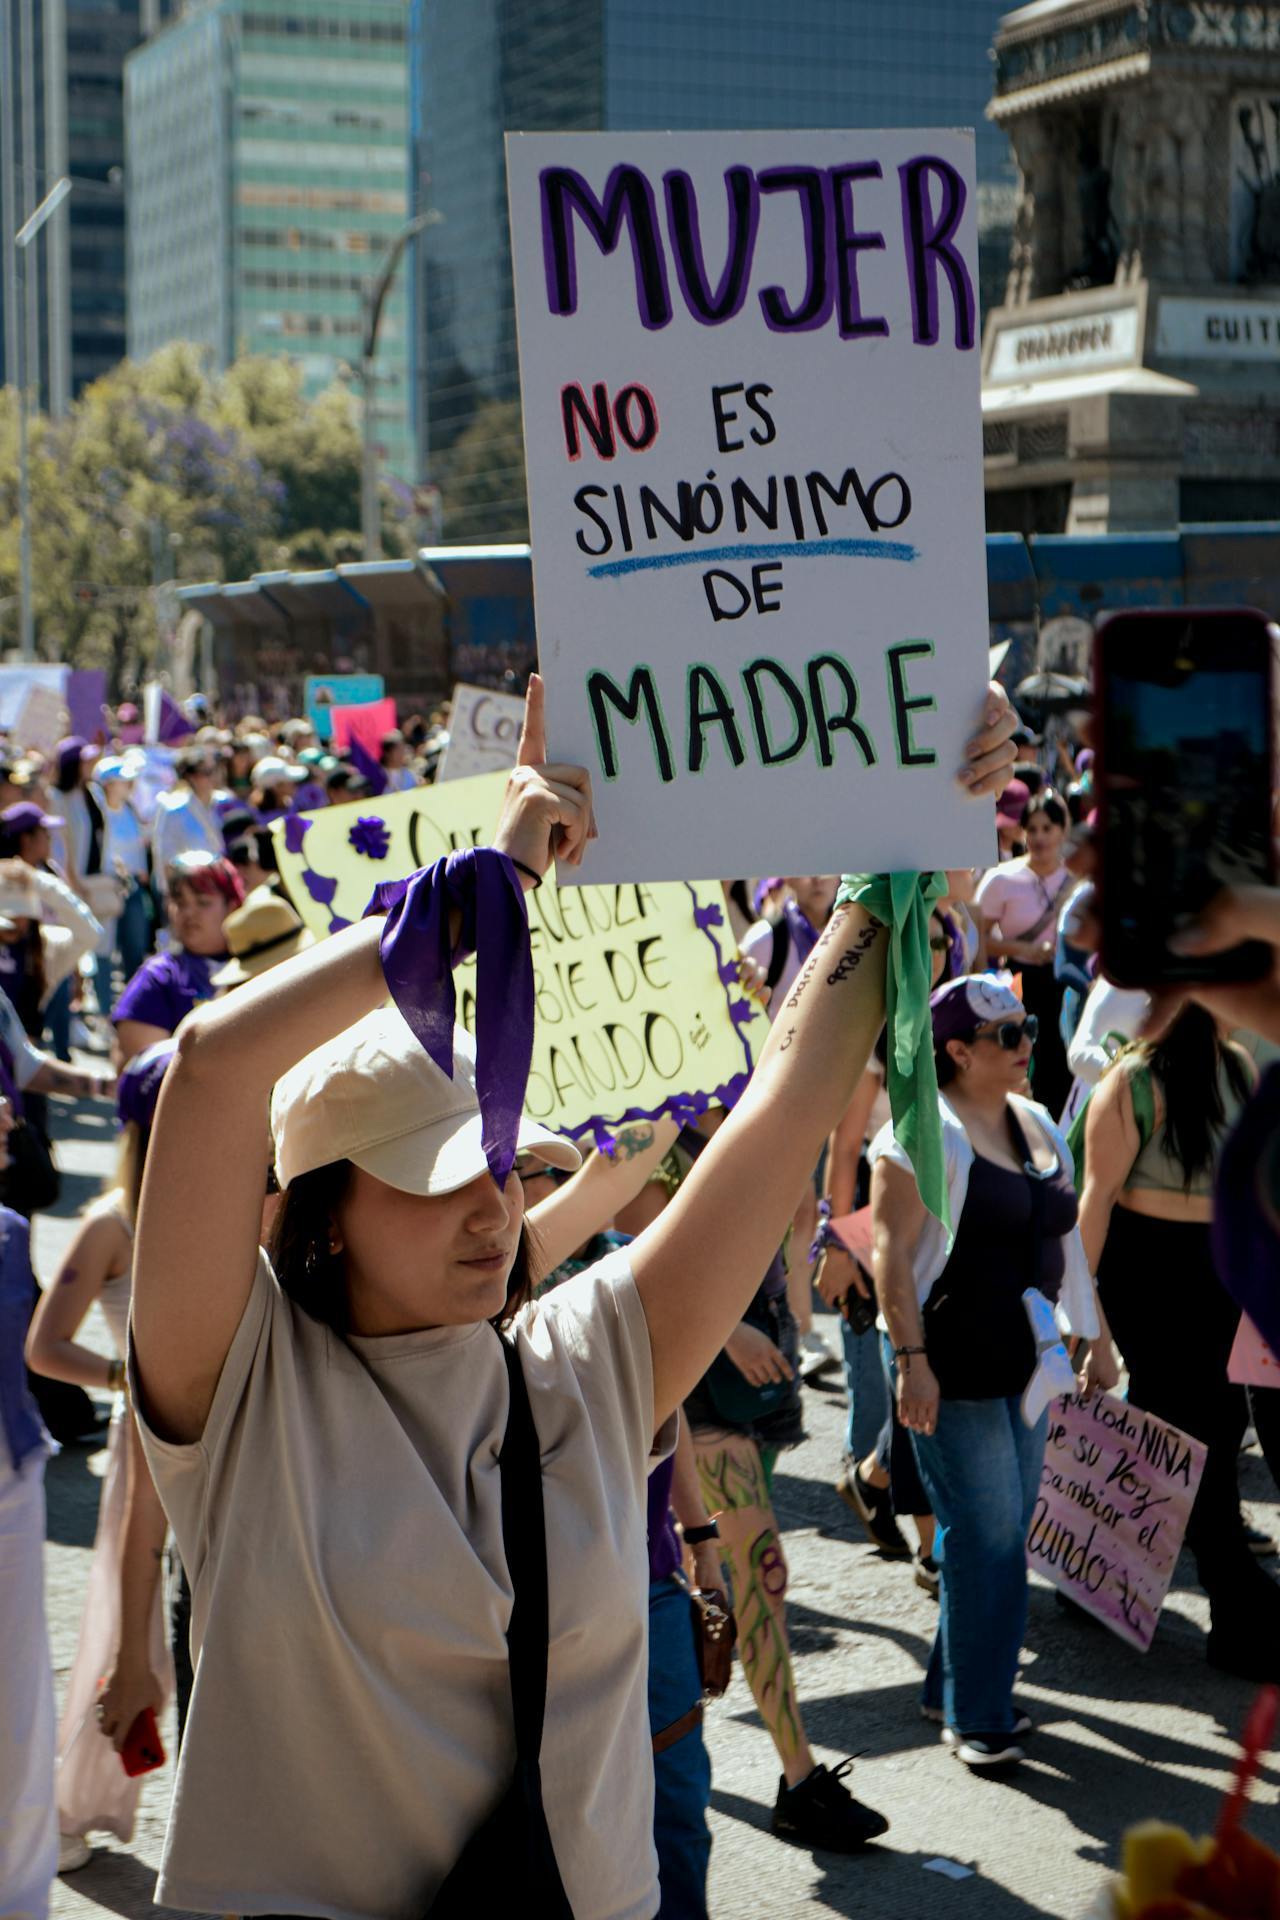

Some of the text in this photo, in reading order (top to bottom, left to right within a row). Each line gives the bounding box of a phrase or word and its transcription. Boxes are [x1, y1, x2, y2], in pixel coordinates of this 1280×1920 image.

[538, 154, 975, 350] MUJER
[1205, 315, 1280, 343] CUIT
[560, 379, 777, 462] NO ES
[573, 468, 912, 556] SINÓNIMO
[703, 562, 783, 622] DE
[586, 639, 939, 783] MADRE
[603, 935, 672, 1002] DE
[1073, 1435, 1103, 1467] su
[1092, 1394, 1138, 1440] toda
[1136, 1418, 1193, 1488] NIÑA
